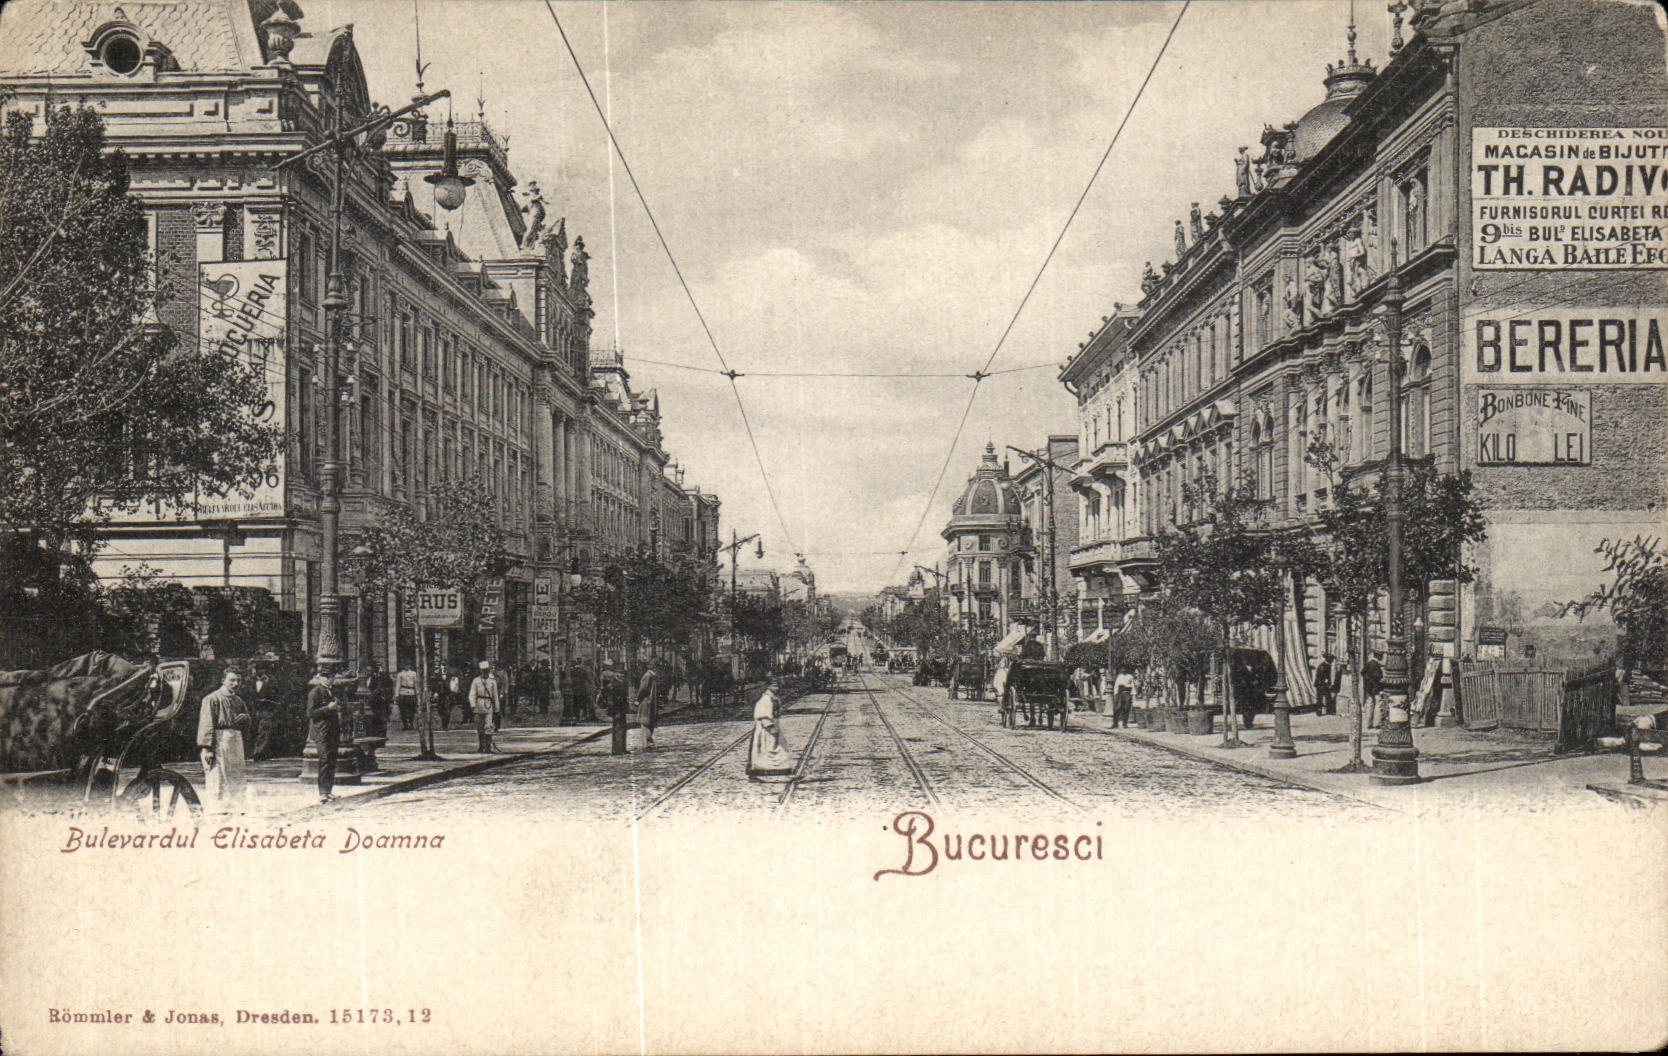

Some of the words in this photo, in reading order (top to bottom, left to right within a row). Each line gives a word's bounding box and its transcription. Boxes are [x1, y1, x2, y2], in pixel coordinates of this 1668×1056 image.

[1498, 129, 1625, 140] DESCHIDEREA
[1583, 147, 1596, 161] de
[1477, 165, 1533, 196] TH.
[1480, 206, 1583, 220] FURNISORUL
[1571, 225, 1663, 242] ELISABETA
[1476, 318, 1667, 373] BERERIA
[1480, 392, 1550, 428] BONBONE
[1480, 433, 1517, 462] KILO
[1554, 432, 1584, 462] LEI
[419, 593, 458, 609] RUS
